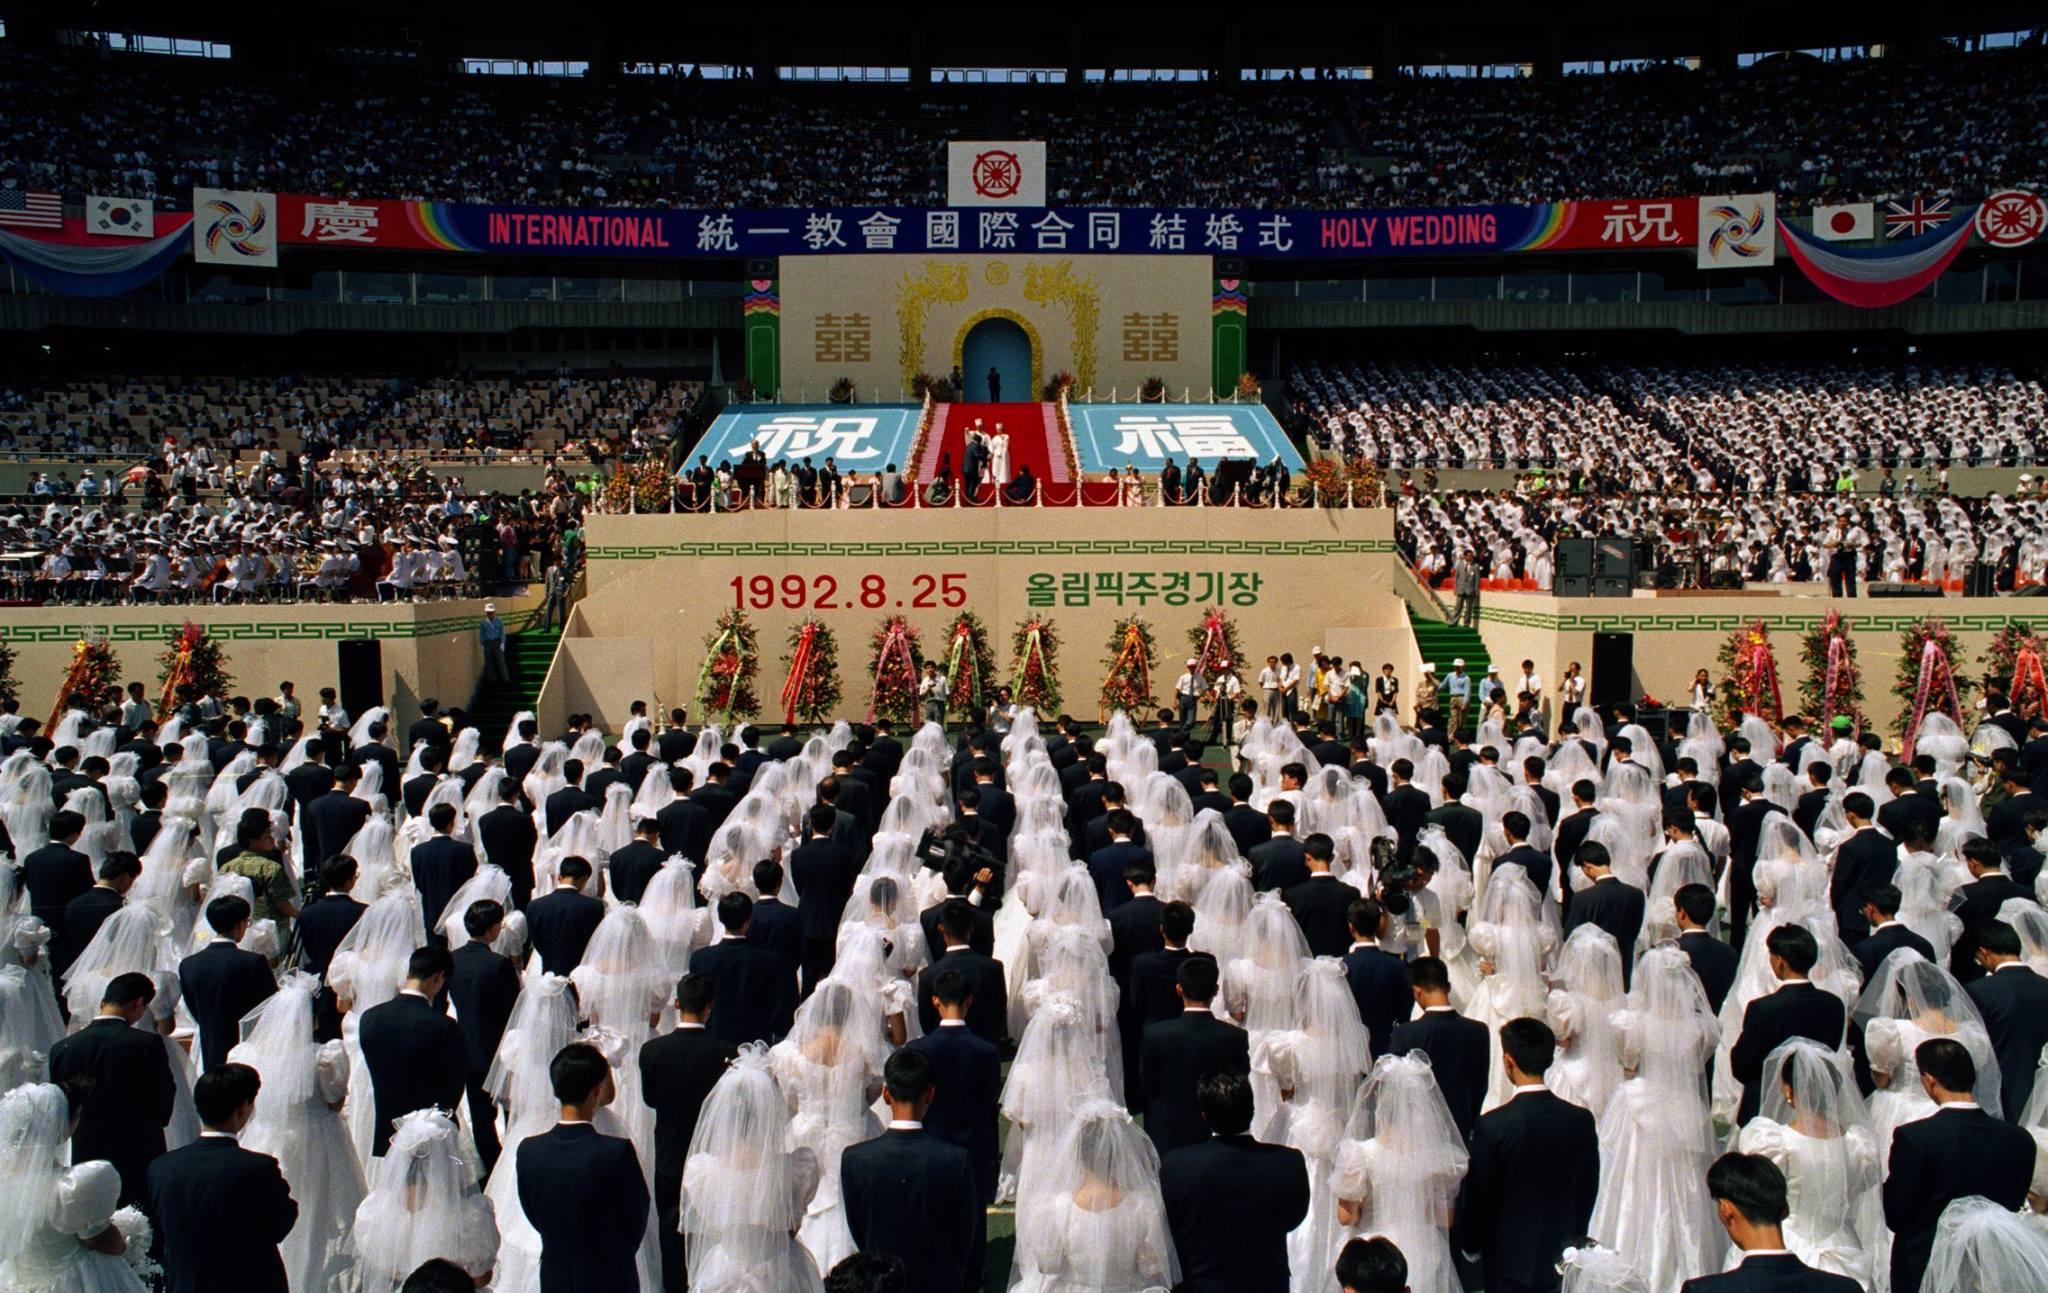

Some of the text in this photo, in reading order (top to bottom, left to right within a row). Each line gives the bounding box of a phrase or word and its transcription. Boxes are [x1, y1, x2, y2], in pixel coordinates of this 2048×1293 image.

[302, 201, 378, 243] 慶
[489, 213, 669, 248] INTERNATIONAL
[1321, 214, 1496, 248] HOLY WEDDING
[1601, 203, 1680, 242] 祝
[728, 417, 881, 459] 祝
[1113, 415, 1259, 458] 福
[730, 572, 968, 610] 1992.8.25
[1025, 571, 1264, 608] 올림픽주경기장
